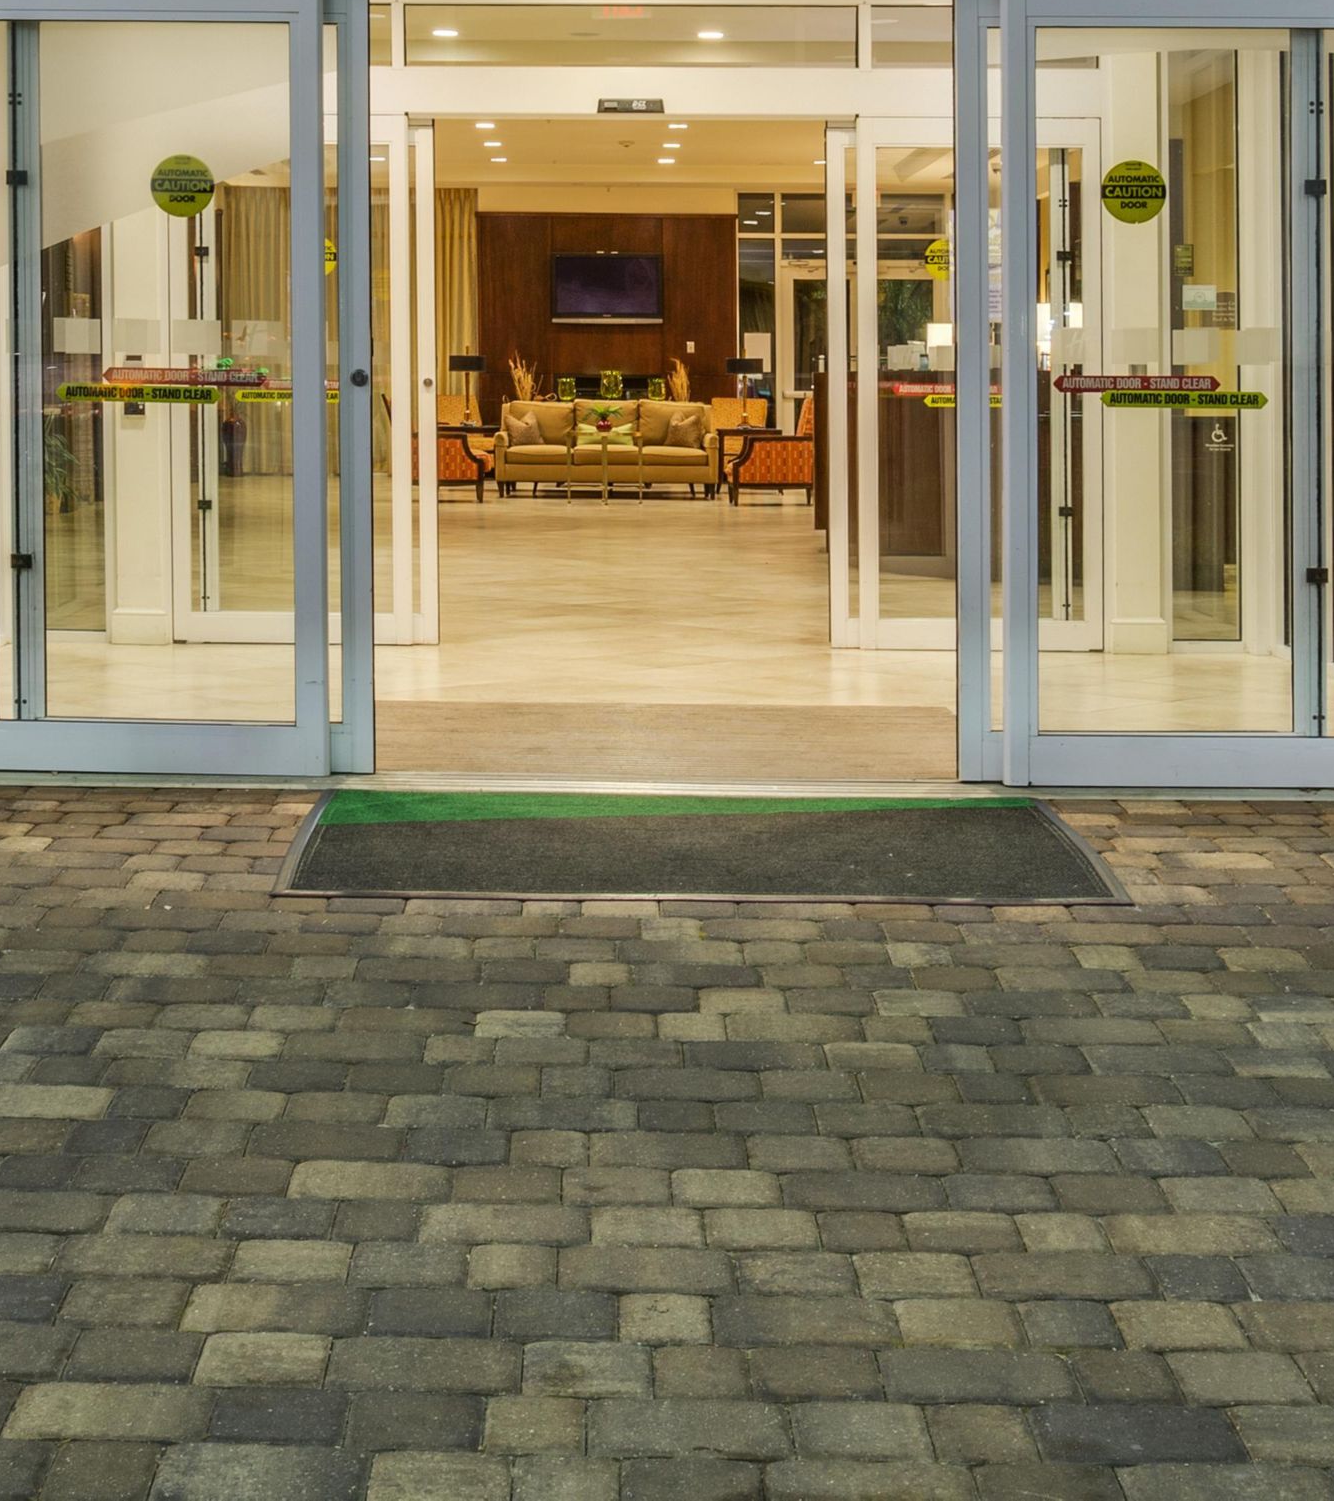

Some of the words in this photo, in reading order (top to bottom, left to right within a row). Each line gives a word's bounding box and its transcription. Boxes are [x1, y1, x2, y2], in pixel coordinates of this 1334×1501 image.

[157, 169, 209, 177] AUTOMATIC
[1107, 175, 1160, 183] AUTOMATIC
[155, 180, 211, 191] CAUTION
[1105, 186, 1162, 197] CAUTION
[1120, 201, 1148, 209] DOOR
[112, 370, 163, 380] AUTOMATIC
[164, 370, 189, 381] DOOR
[197, 371, 226, 382] STAND
[1062, 378, 1114, 389] AUTOMATIC
[1117, 378, 1141, 389] DOOR
[1150, 378, 1180, 389] STAND
[1181, 378, 1212, 389] CLEAR
[66, 386, 117, 398] AUTOMATIC
[119, 387, 144, 398] DOOR
[151, 388, 181, 399] STAND
[183, 389, 212, 400] CLEAR
[1110, 393, 1162, 404] AUTOMATIC
[1164, 394, 1190, 404] DOOR
[1198, 394, 1228, 405] STAND
[1230, 395, 1259, 405] CLEAR
